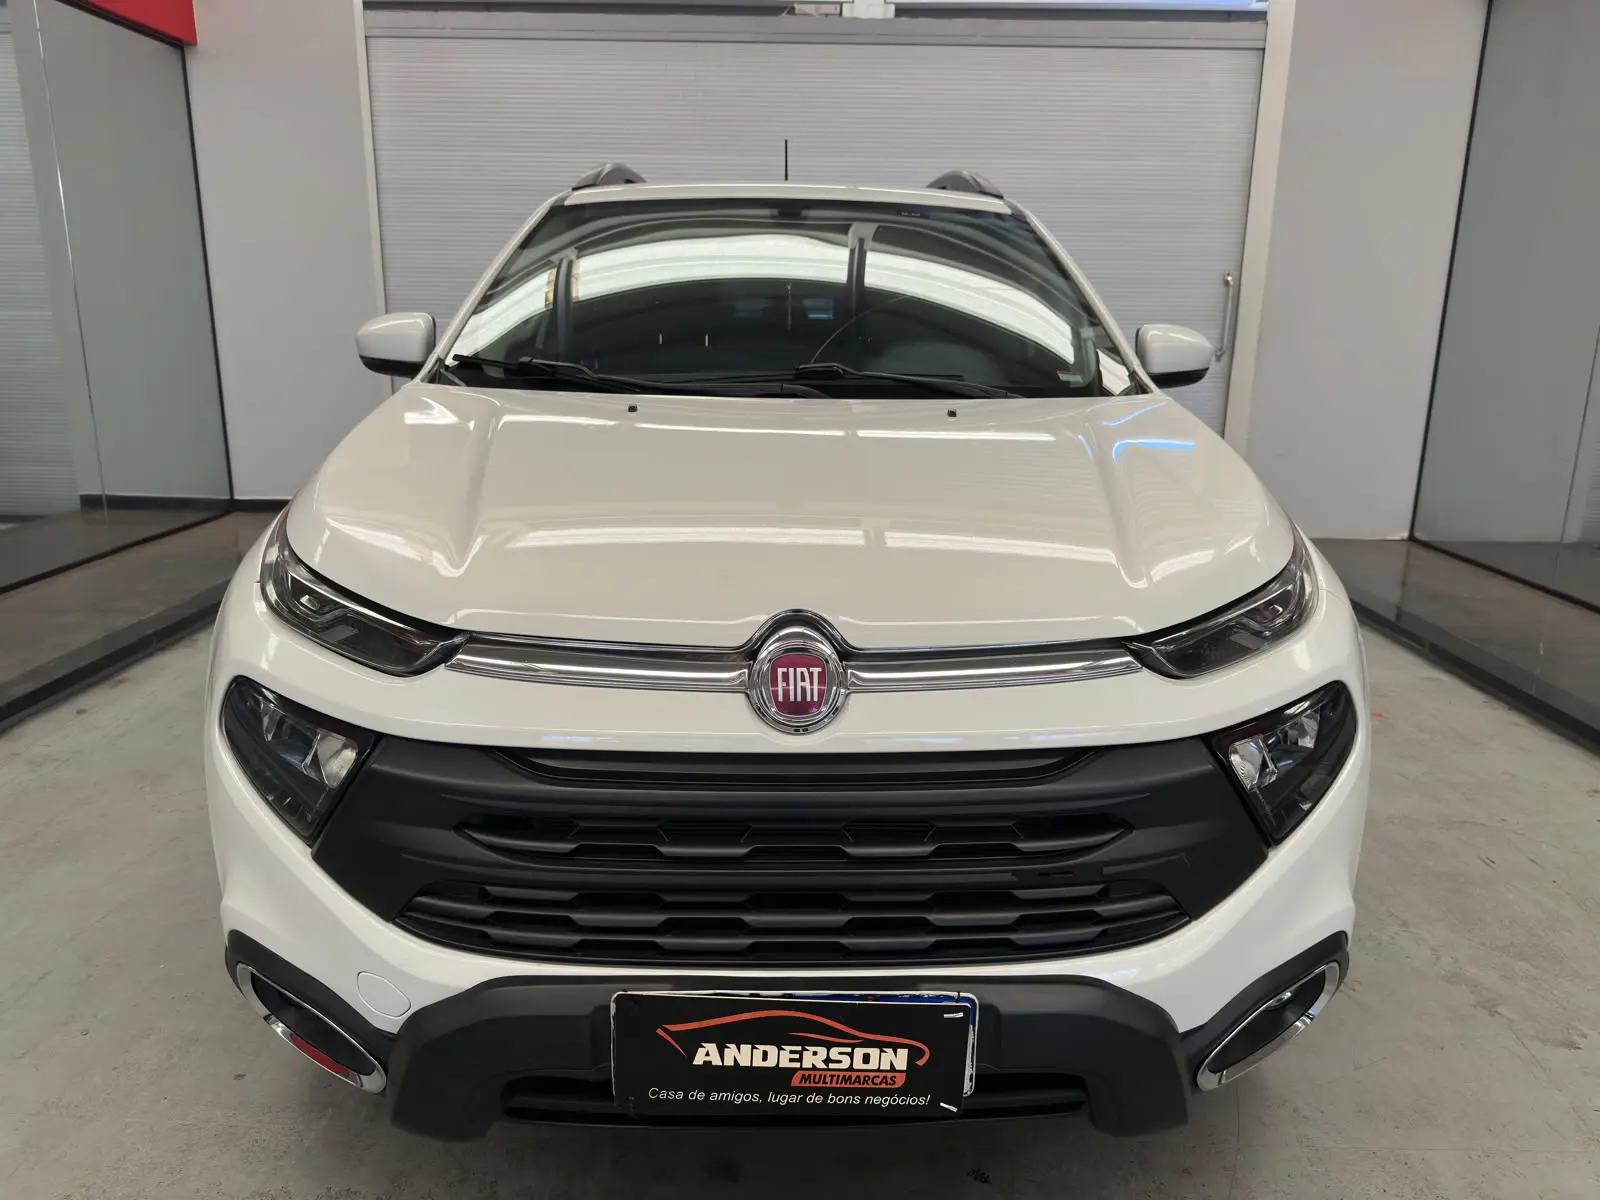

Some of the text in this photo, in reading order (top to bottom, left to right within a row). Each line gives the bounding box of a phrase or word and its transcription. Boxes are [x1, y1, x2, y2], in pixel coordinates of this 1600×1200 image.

[777, 667, 822, 702] FIAT
[692, 1042, 909, 1071] ANDERSON
[799, 1073, 897, 1086] MULTIMARCAS
[648, 1087, 931, 1107] Casa de amigos, lugar de bons negócios!
